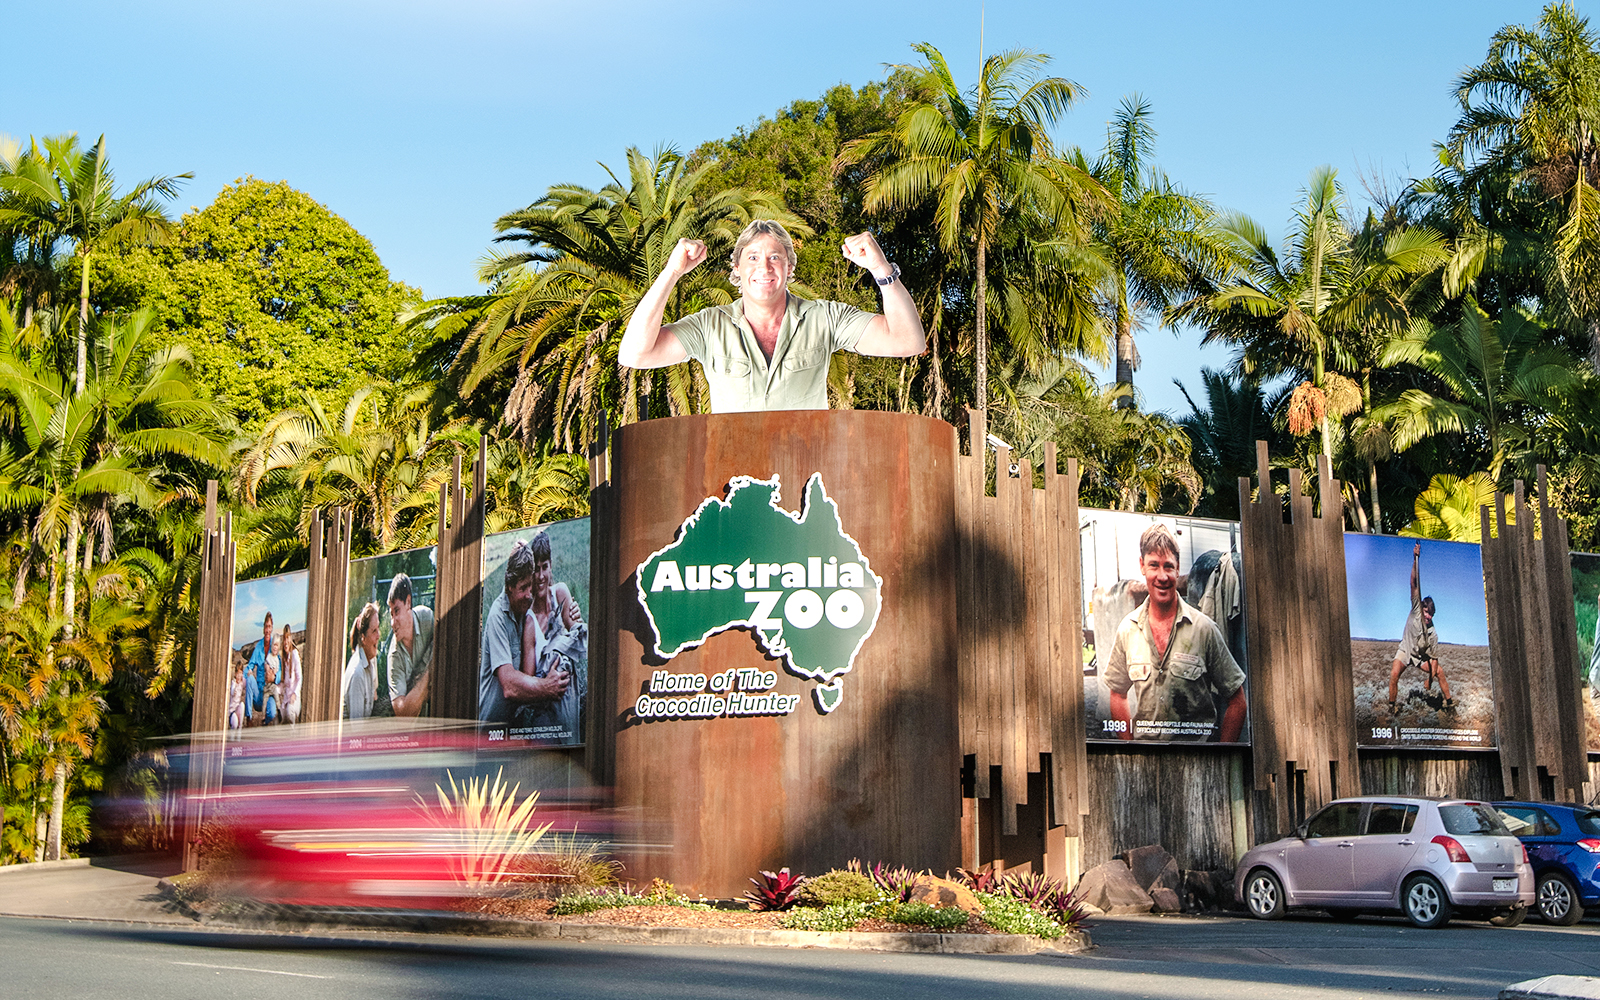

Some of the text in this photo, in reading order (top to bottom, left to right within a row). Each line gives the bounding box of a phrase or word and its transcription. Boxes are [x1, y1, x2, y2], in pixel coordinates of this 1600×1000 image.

[650, 556, 865, 592] Australia
[744, 588, 865, 630] ZOO
[652, 670, 775, 690] Home of The
[637, 693, 797, 715] Crocodile Hunter
[488, 729, 505, 741] 2002
[1102, 719, 1127, 732] 1998
[1371, 727, 1392, 739] 1996
